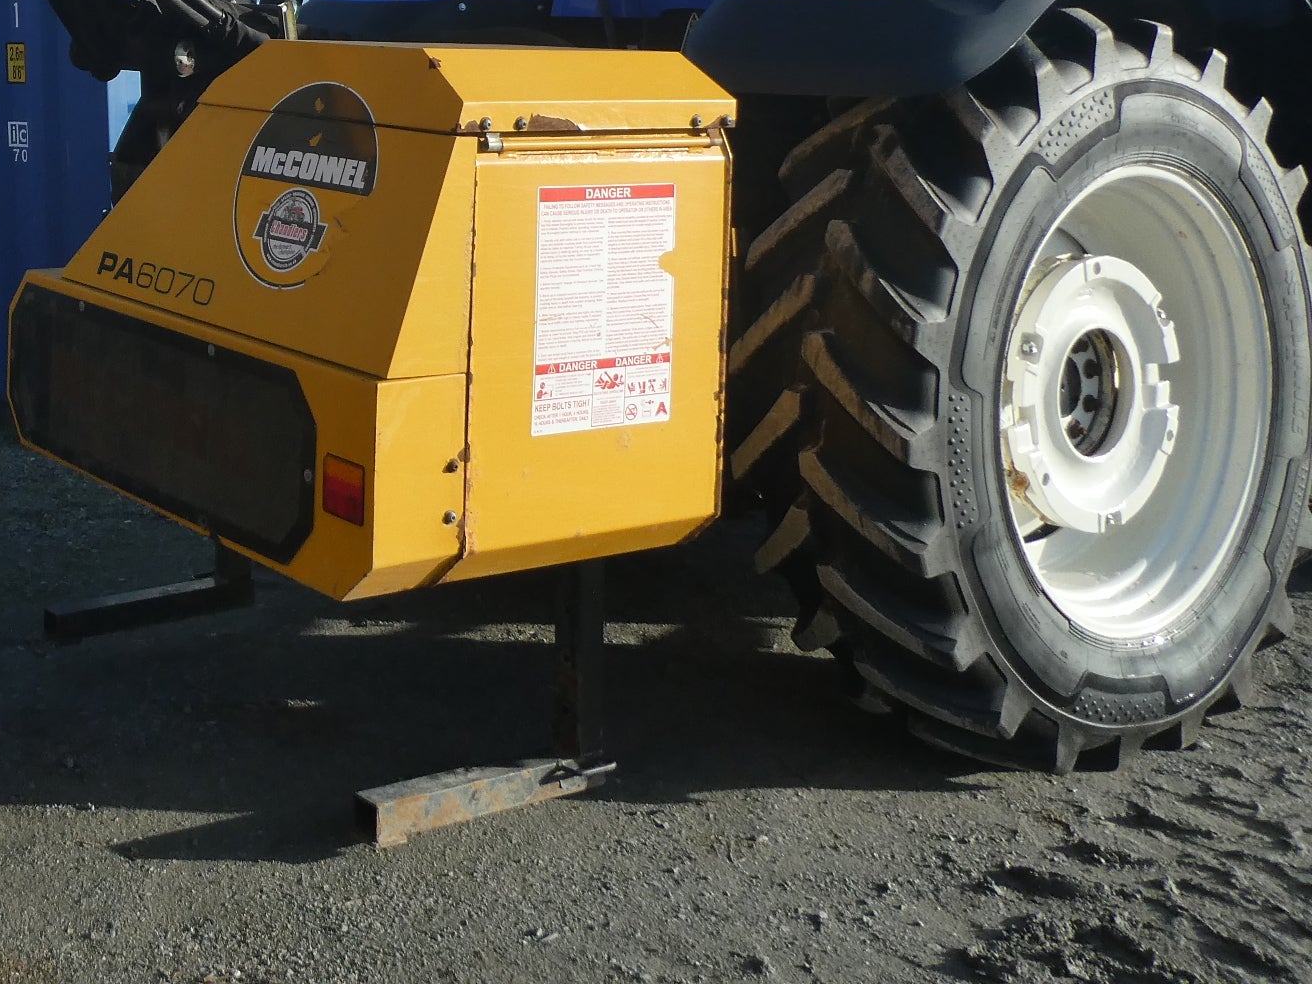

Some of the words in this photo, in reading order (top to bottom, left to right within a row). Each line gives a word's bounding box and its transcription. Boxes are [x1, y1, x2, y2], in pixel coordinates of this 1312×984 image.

[13, 148, 28, 162] 70
[585, 187, 632, 199] DANGER
[96, 251, 215, 306] PA6070
[559, 360, 598, 372] DANGER
[615, 355, 652, 367] DANGER
[535, 403, 551, 413] KEEP
[552, 401, 572, 411] BOLTS
